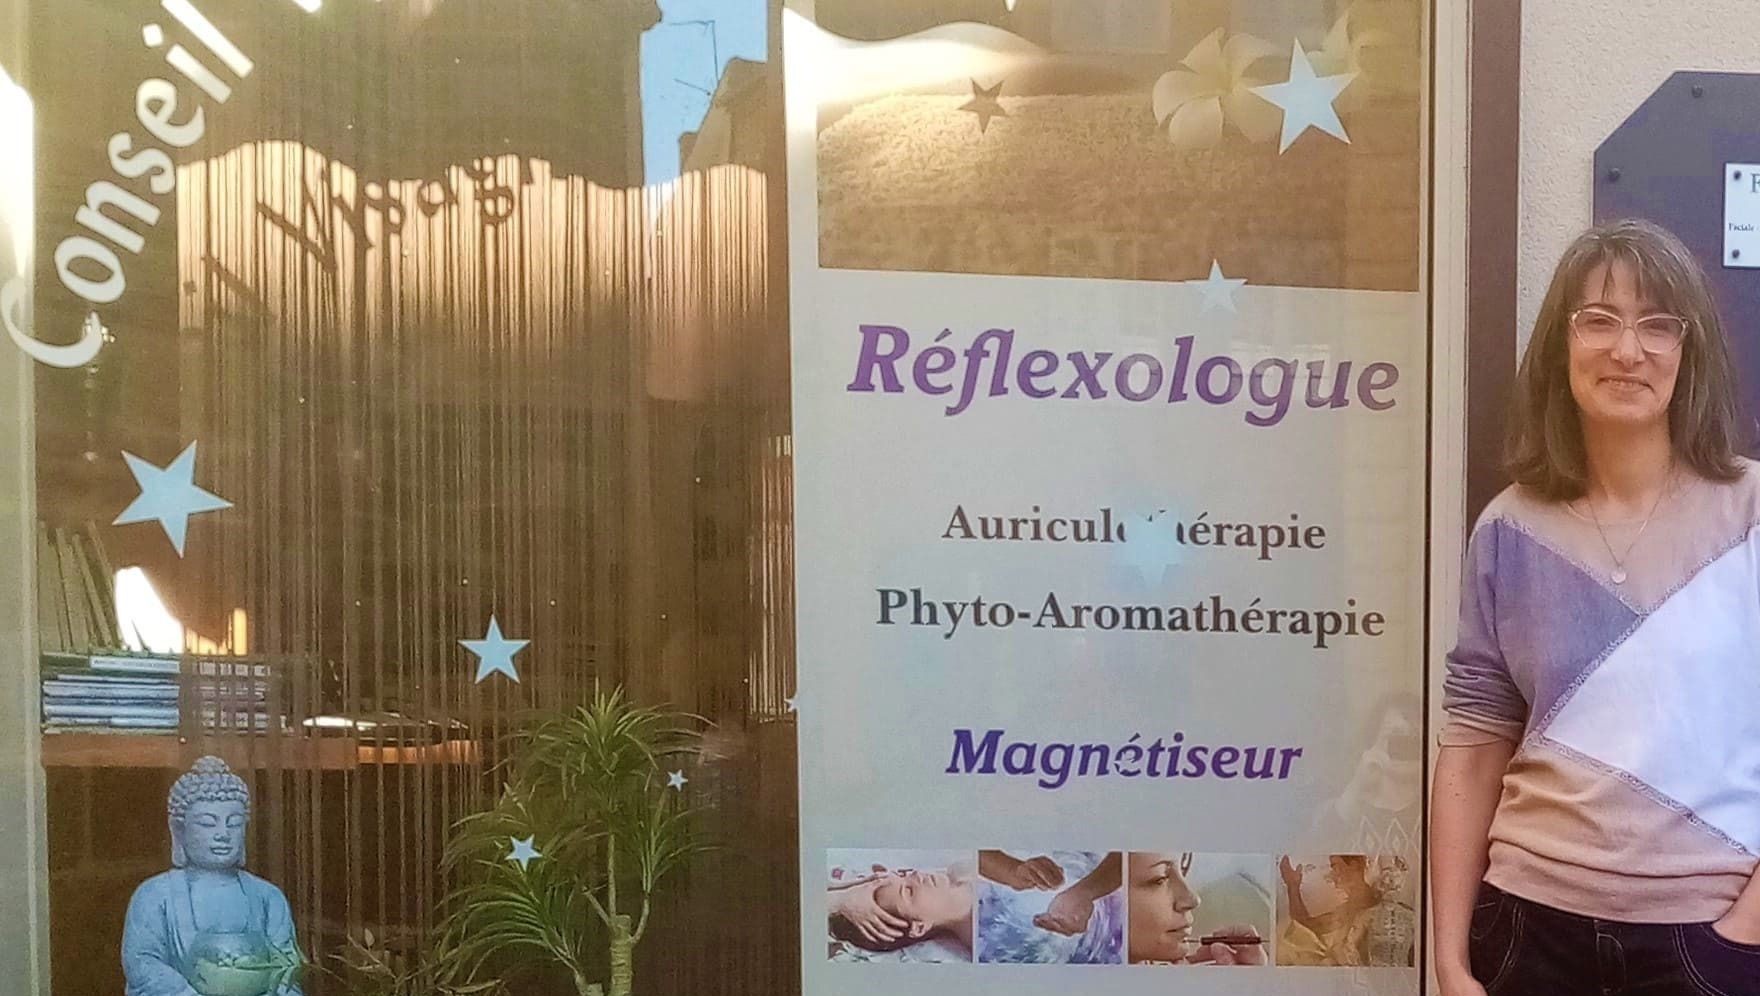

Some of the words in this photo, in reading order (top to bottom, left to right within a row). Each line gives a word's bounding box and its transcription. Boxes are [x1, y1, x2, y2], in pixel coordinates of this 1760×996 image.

[0, 0, 254, 368] Conseil
[847, 324, 1400, 427] Réflexologue
[942, 505, 1326, 560] Auriculérapie
[876, 587, 1386, 648] Phyto-Aromathérapie
[945, 729, 1304, 789] Magnétiseur
